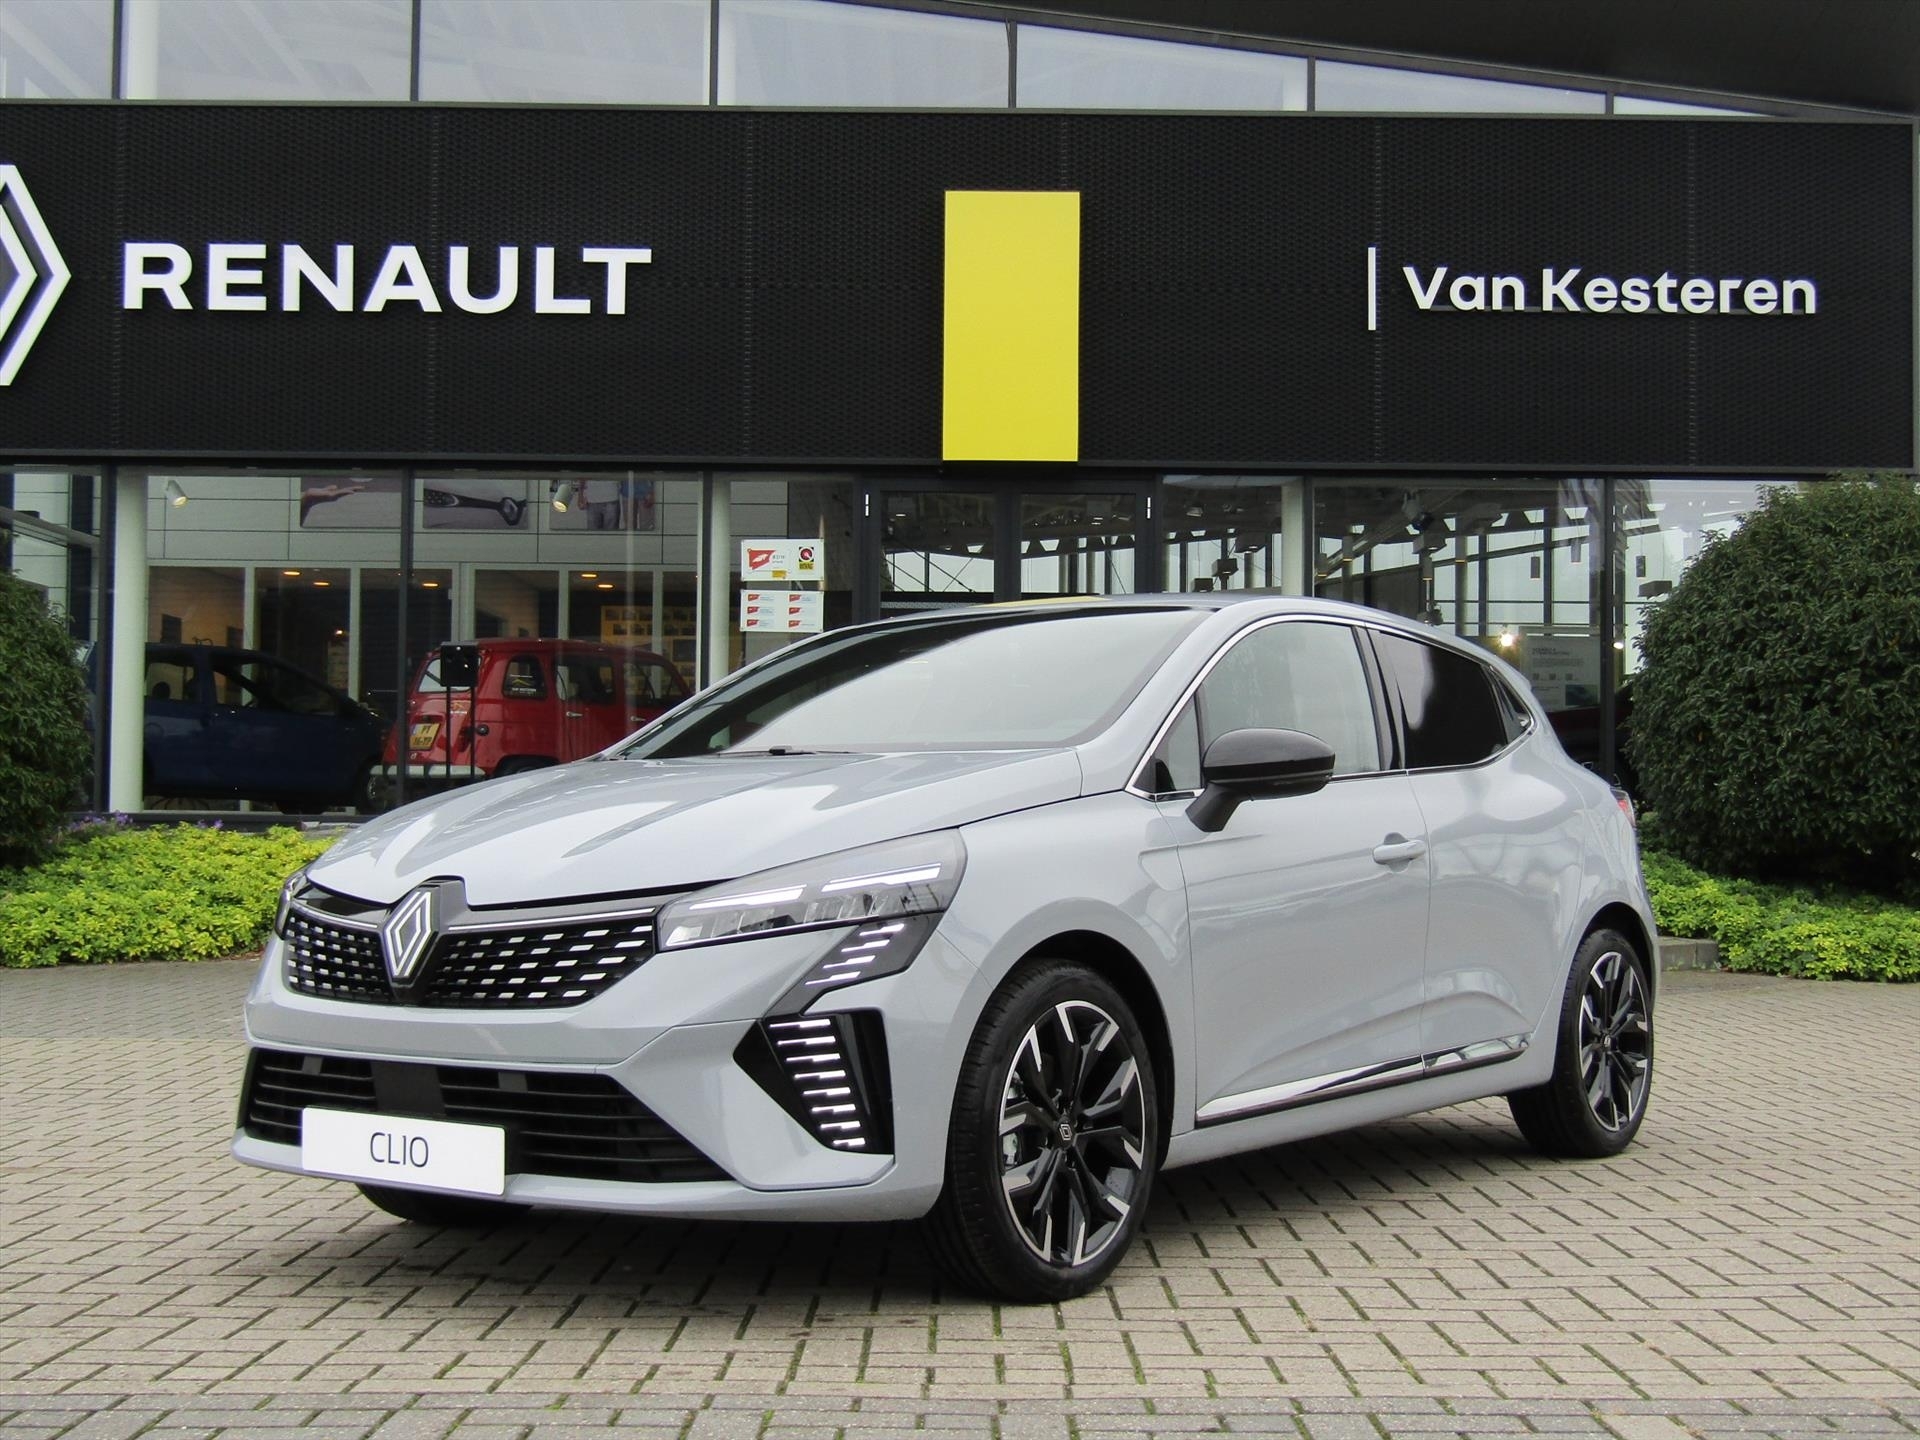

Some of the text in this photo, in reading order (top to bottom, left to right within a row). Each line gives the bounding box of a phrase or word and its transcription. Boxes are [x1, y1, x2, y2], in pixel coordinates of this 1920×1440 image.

[123, 242, 652, 315] RENAULT
[1402, 266, 1817, 315] Van Kesteren
[370, 1131, 430, 1168] CLIO
